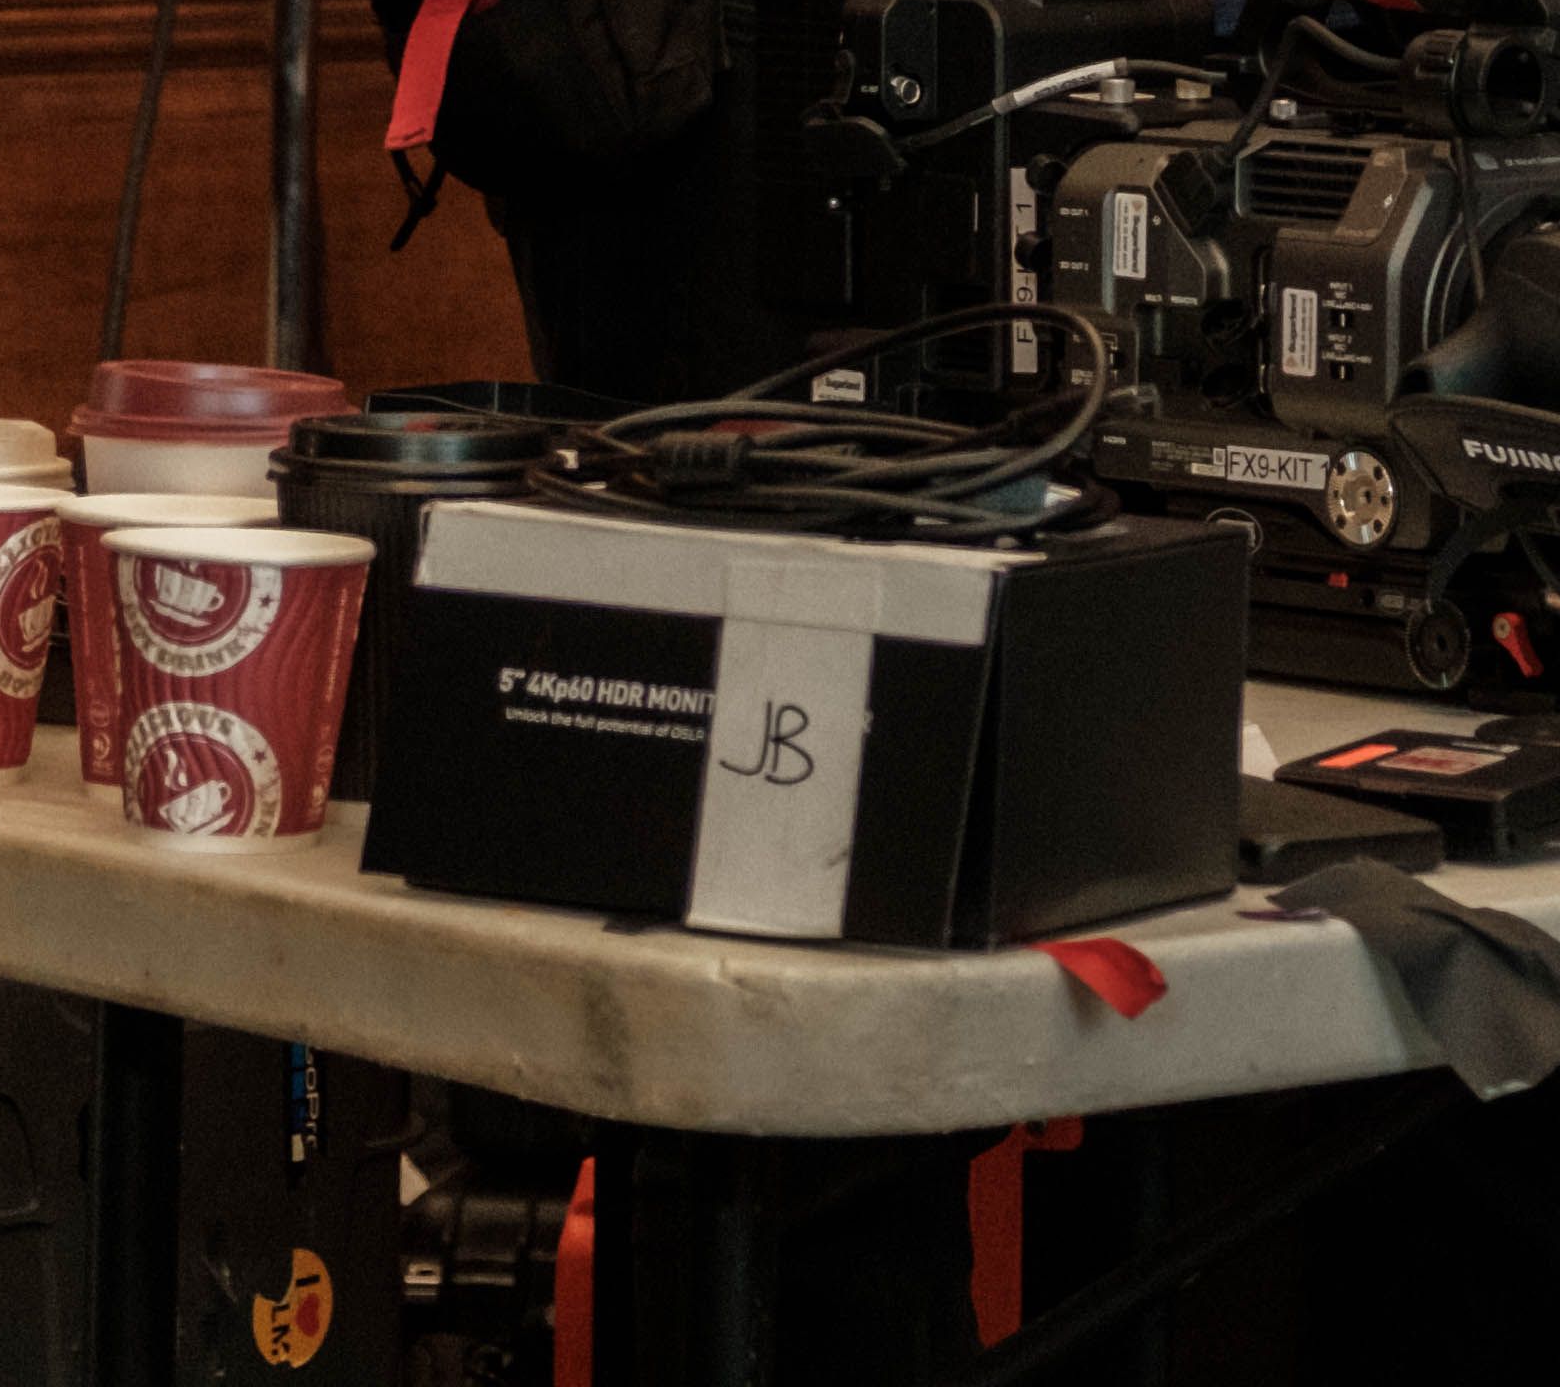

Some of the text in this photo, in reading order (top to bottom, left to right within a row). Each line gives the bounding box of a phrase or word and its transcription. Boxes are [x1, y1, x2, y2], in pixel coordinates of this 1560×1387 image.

[1228, 456, 1313, 481] FX9-KIT
[526, 671, 593, 706] 4Kp60
[597, 678, 645, 707] HDR
[647, 685, 717, 716] MONIT
[719, 701, 815, 786] JB
